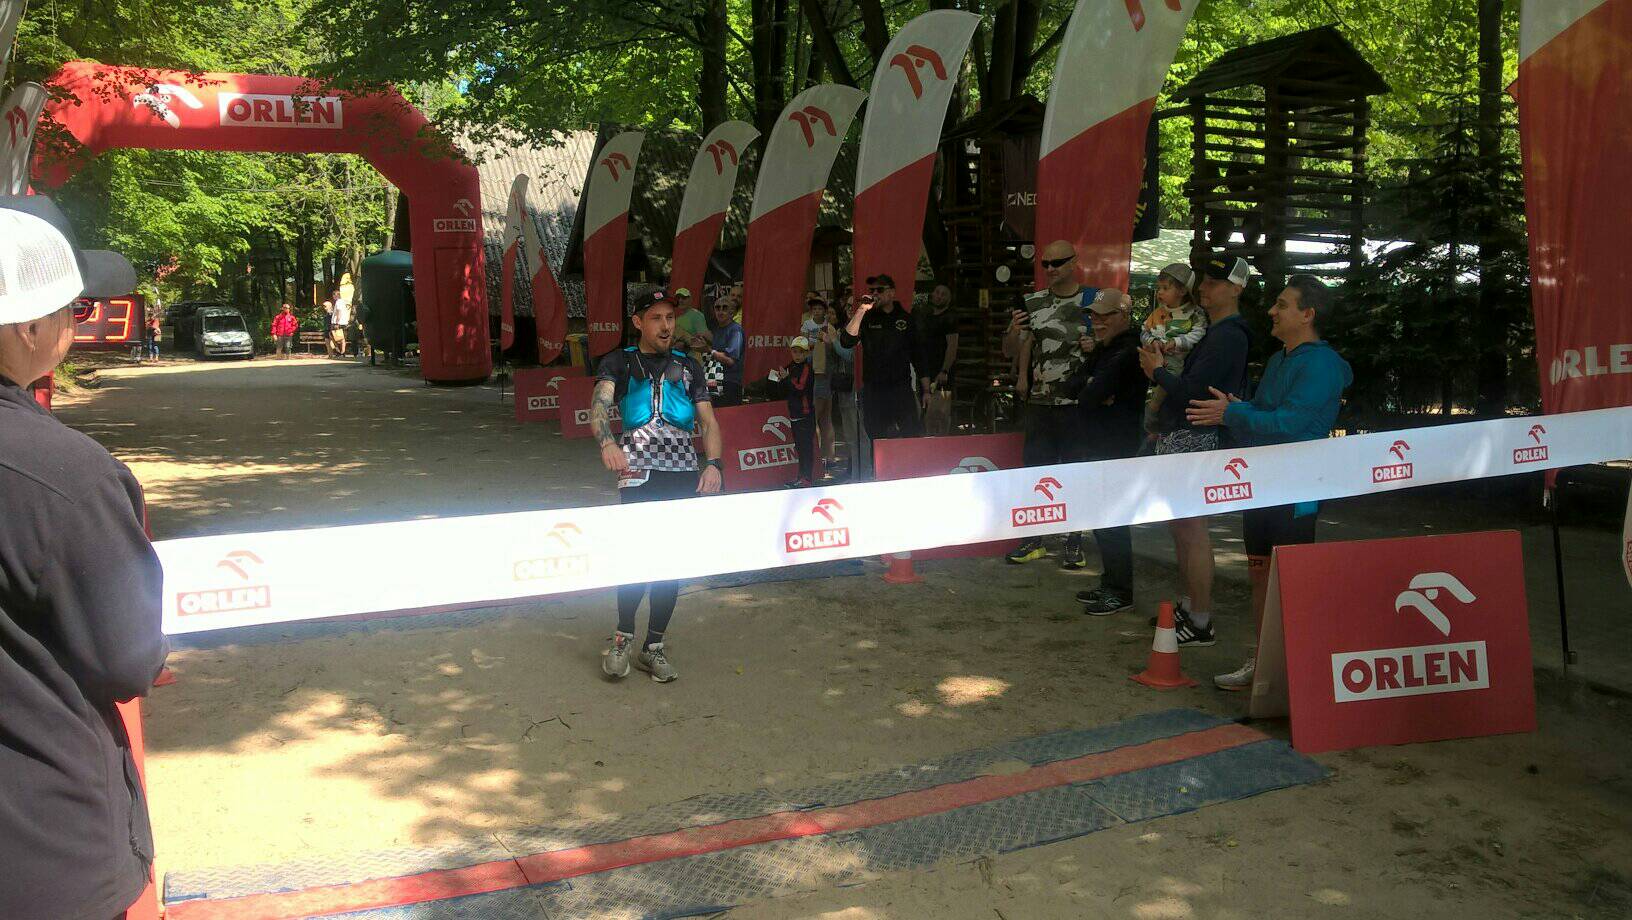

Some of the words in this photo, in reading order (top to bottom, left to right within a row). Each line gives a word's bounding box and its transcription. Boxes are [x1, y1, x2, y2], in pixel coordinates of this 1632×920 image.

[227, 98, 335, 123] ORLEN
[436, 220, 475, 231] ORLEN
[1514, 447, 1547, 462] ORLEN
[1374, 465, 1411, 481] ORLEN
[1206, 484, 1250, 501] ORLEN
[1014, 505, 1064, 524] ORLEN
[788, 529, 847, 550] ORLEN
[180, 588, 265, 613] ORLEN
[1341, 649, 1479, 694] ORLEN
